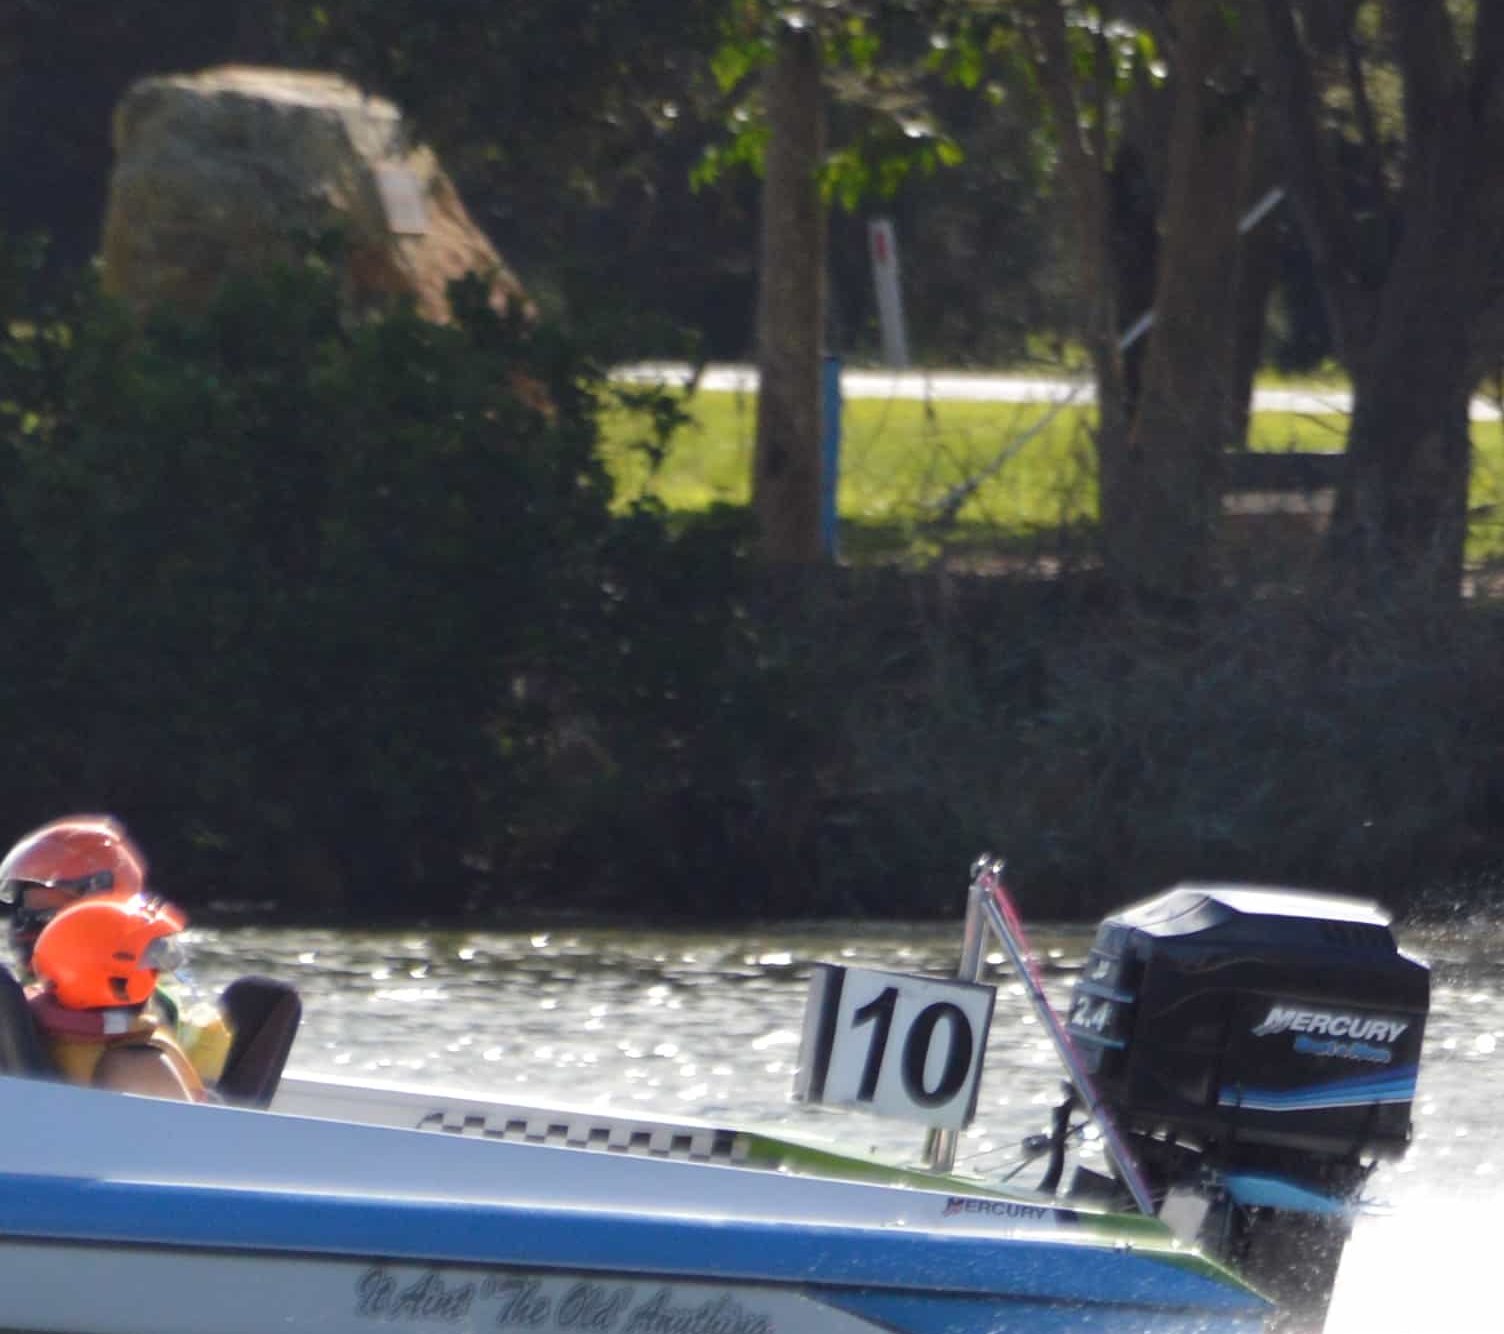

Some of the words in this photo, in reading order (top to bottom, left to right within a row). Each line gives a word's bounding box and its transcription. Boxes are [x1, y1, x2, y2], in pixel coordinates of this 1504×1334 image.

[1071, 995, 1113, 1033] 2.4
[1251, 1005, 1409, 1044] MERCURY
[851, 986, 974, 1110] 10
[942, 1196, 1047, 1219] MERCURY
